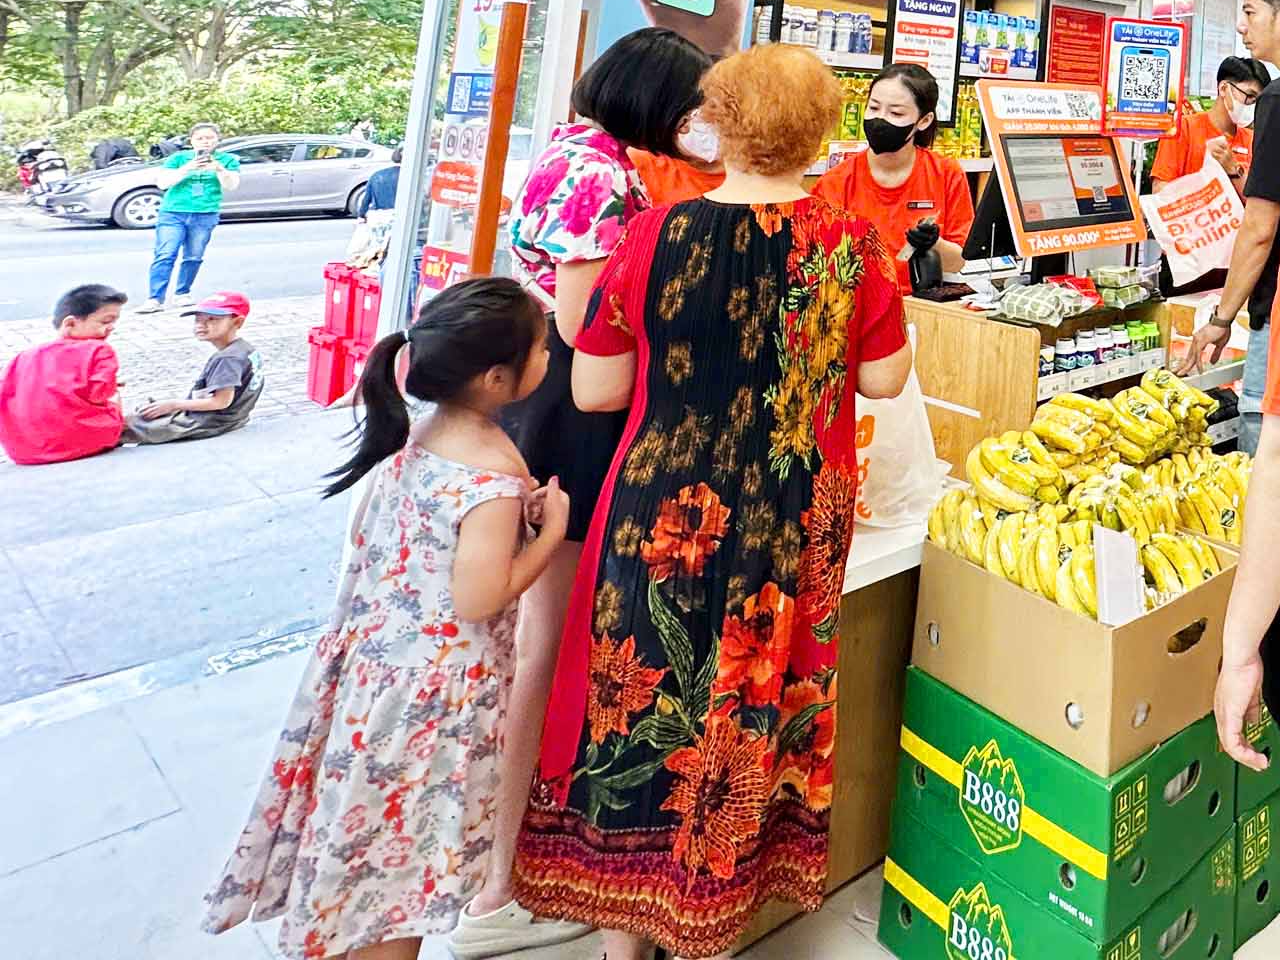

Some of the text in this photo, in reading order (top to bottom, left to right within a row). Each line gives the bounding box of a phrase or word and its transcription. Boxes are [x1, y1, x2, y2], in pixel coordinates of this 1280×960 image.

[930, 2, 952, 15] NGAY
[1195, 196, 1233, 229] Chợ
[963, 769, 1020, 832] B888
